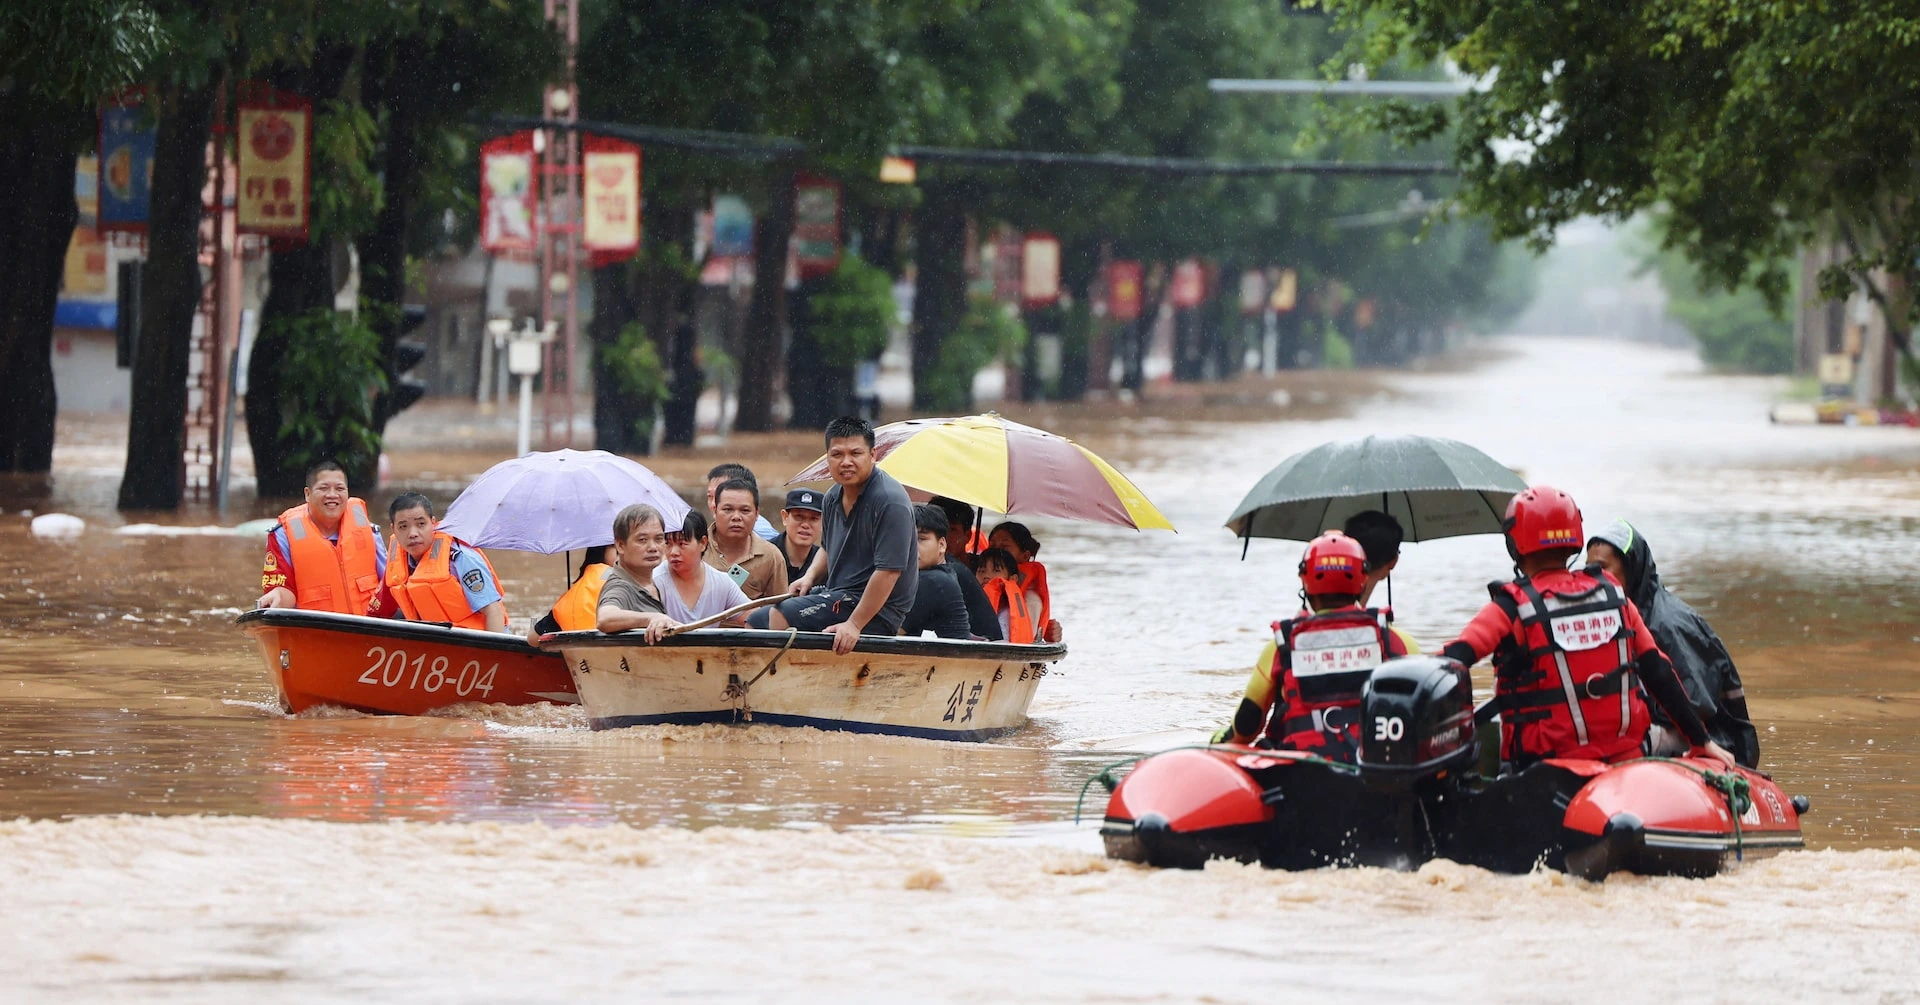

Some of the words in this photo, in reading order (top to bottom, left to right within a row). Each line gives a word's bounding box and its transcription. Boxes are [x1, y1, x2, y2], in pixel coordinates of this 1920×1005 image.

[1557, 616, 1616, 634] 中国消防
[1303, 647, 1371, 664] 中国消防
[358, 646, 499, 698] 2018-04
[942, 680, 983, 723] 公安
[1375, 716, 1404, 741] 30
